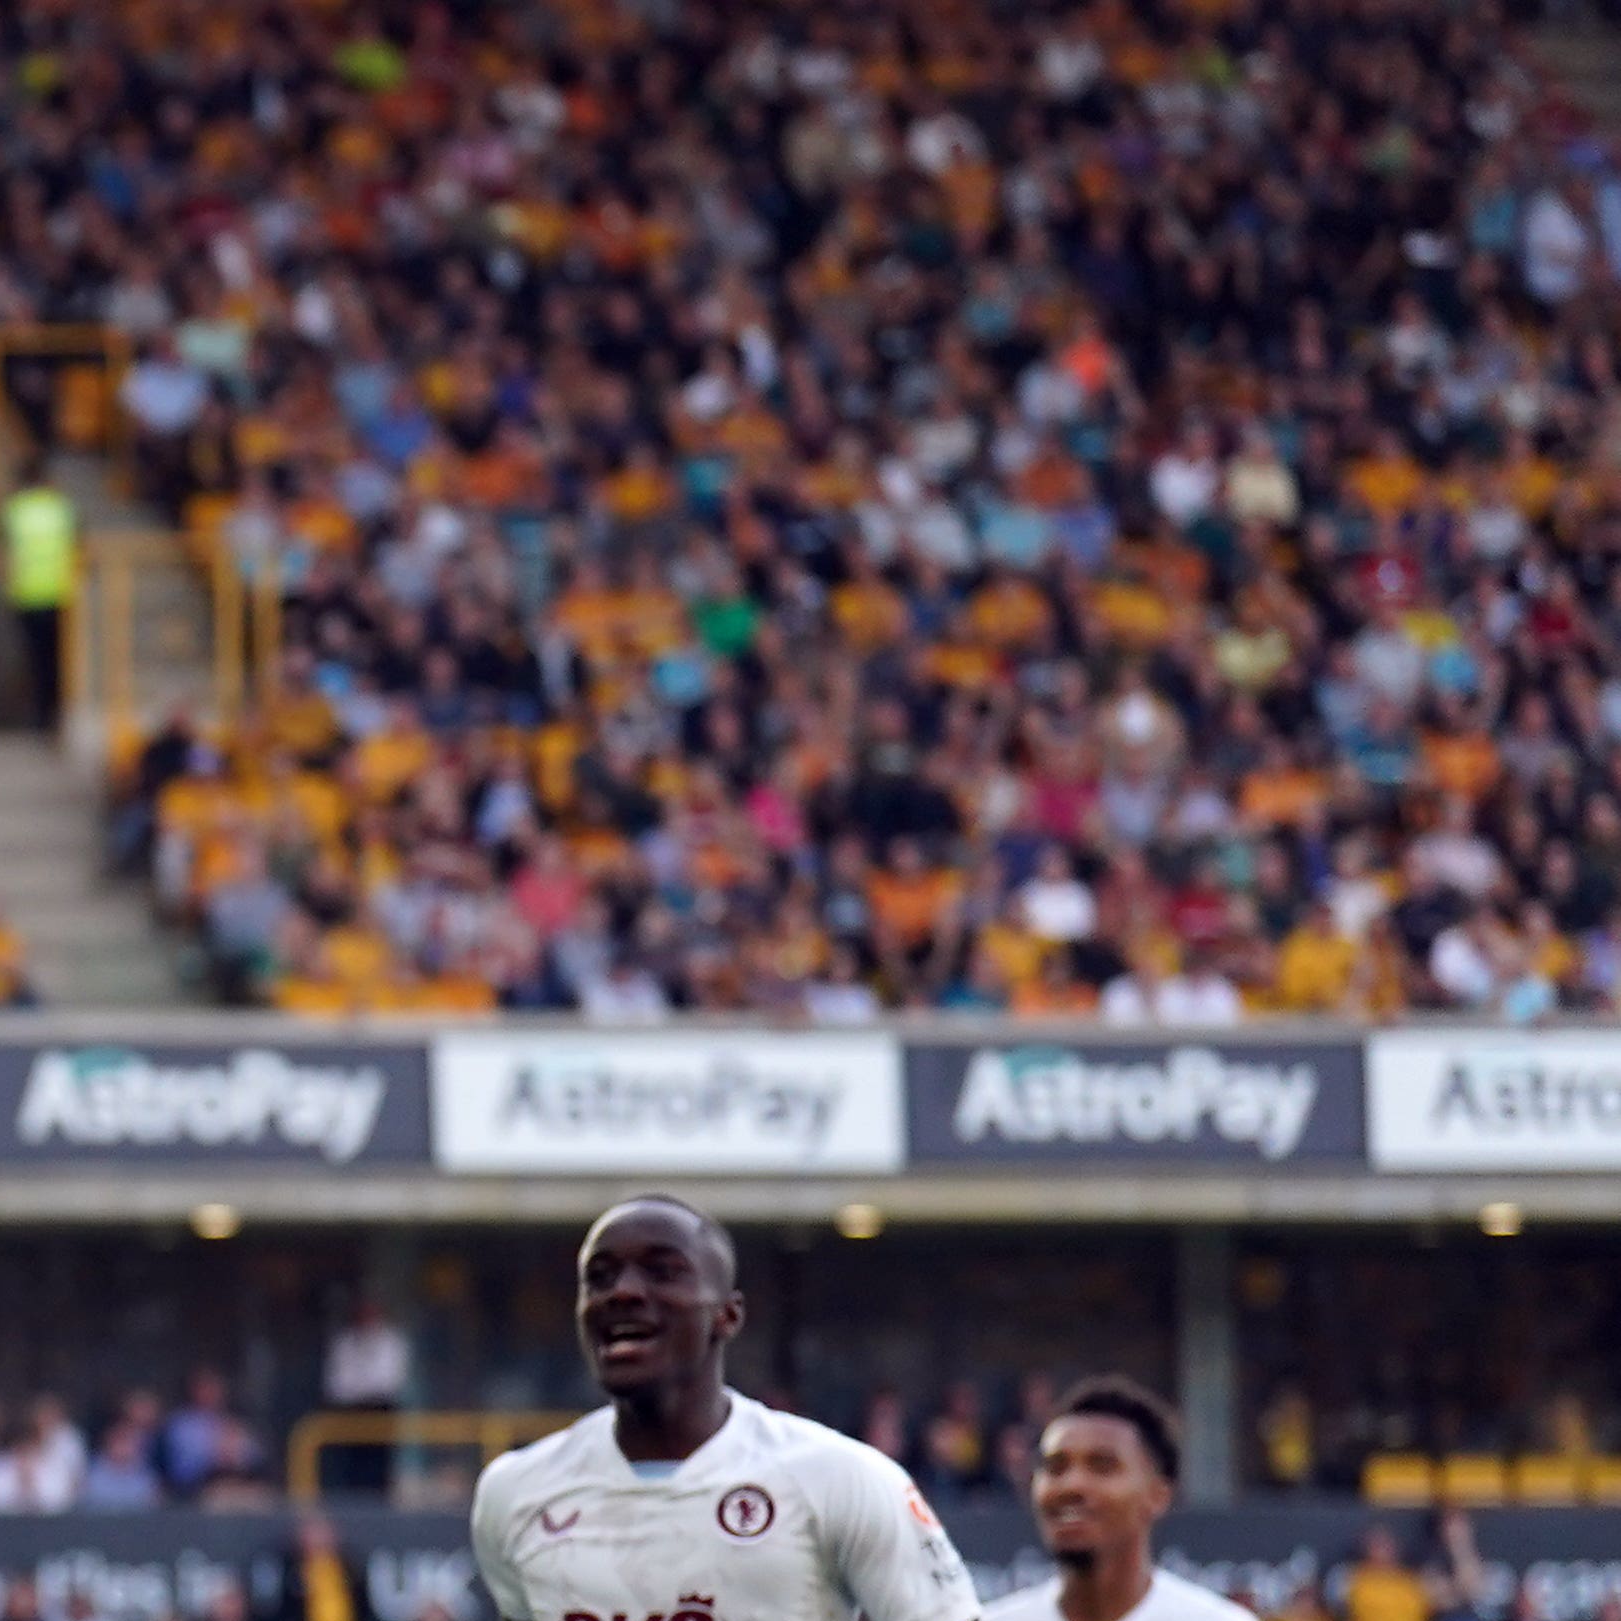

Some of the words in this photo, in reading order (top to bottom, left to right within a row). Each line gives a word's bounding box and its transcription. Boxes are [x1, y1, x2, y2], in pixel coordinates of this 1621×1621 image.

[16, 1046, 390, 1160] AstroPay
[496, 1054, 848, 1144] AstroPay
[956, 1046, 1320, 1160] AstroPay
[1426, 1056, 1621, 1138] Astro
